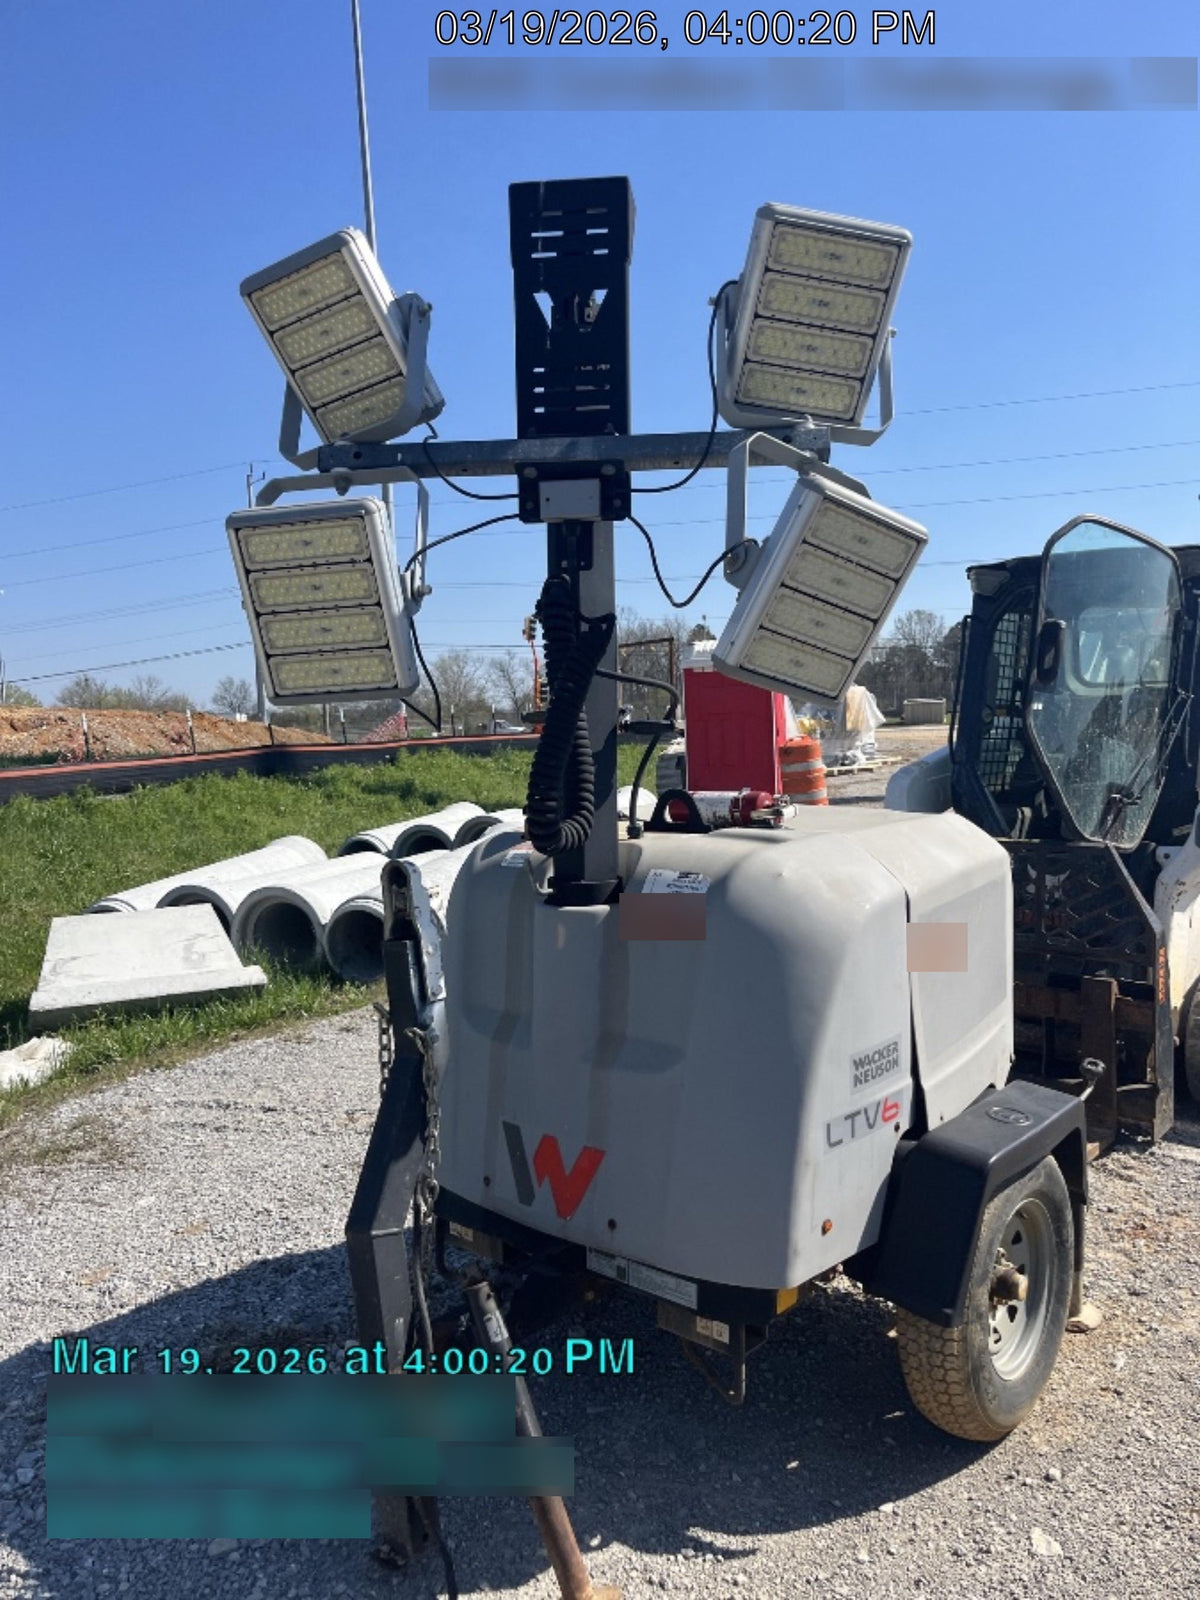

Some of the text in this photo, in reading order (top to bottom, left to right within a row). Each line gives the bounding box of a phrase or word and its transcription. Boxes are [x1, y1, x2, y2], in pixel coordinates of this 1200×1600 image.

[853, 1041, 899, 1071] WACKER
[853, 1054, 899, 1088] NEUSON
[826, 1097, 900, 1148] LTV6
